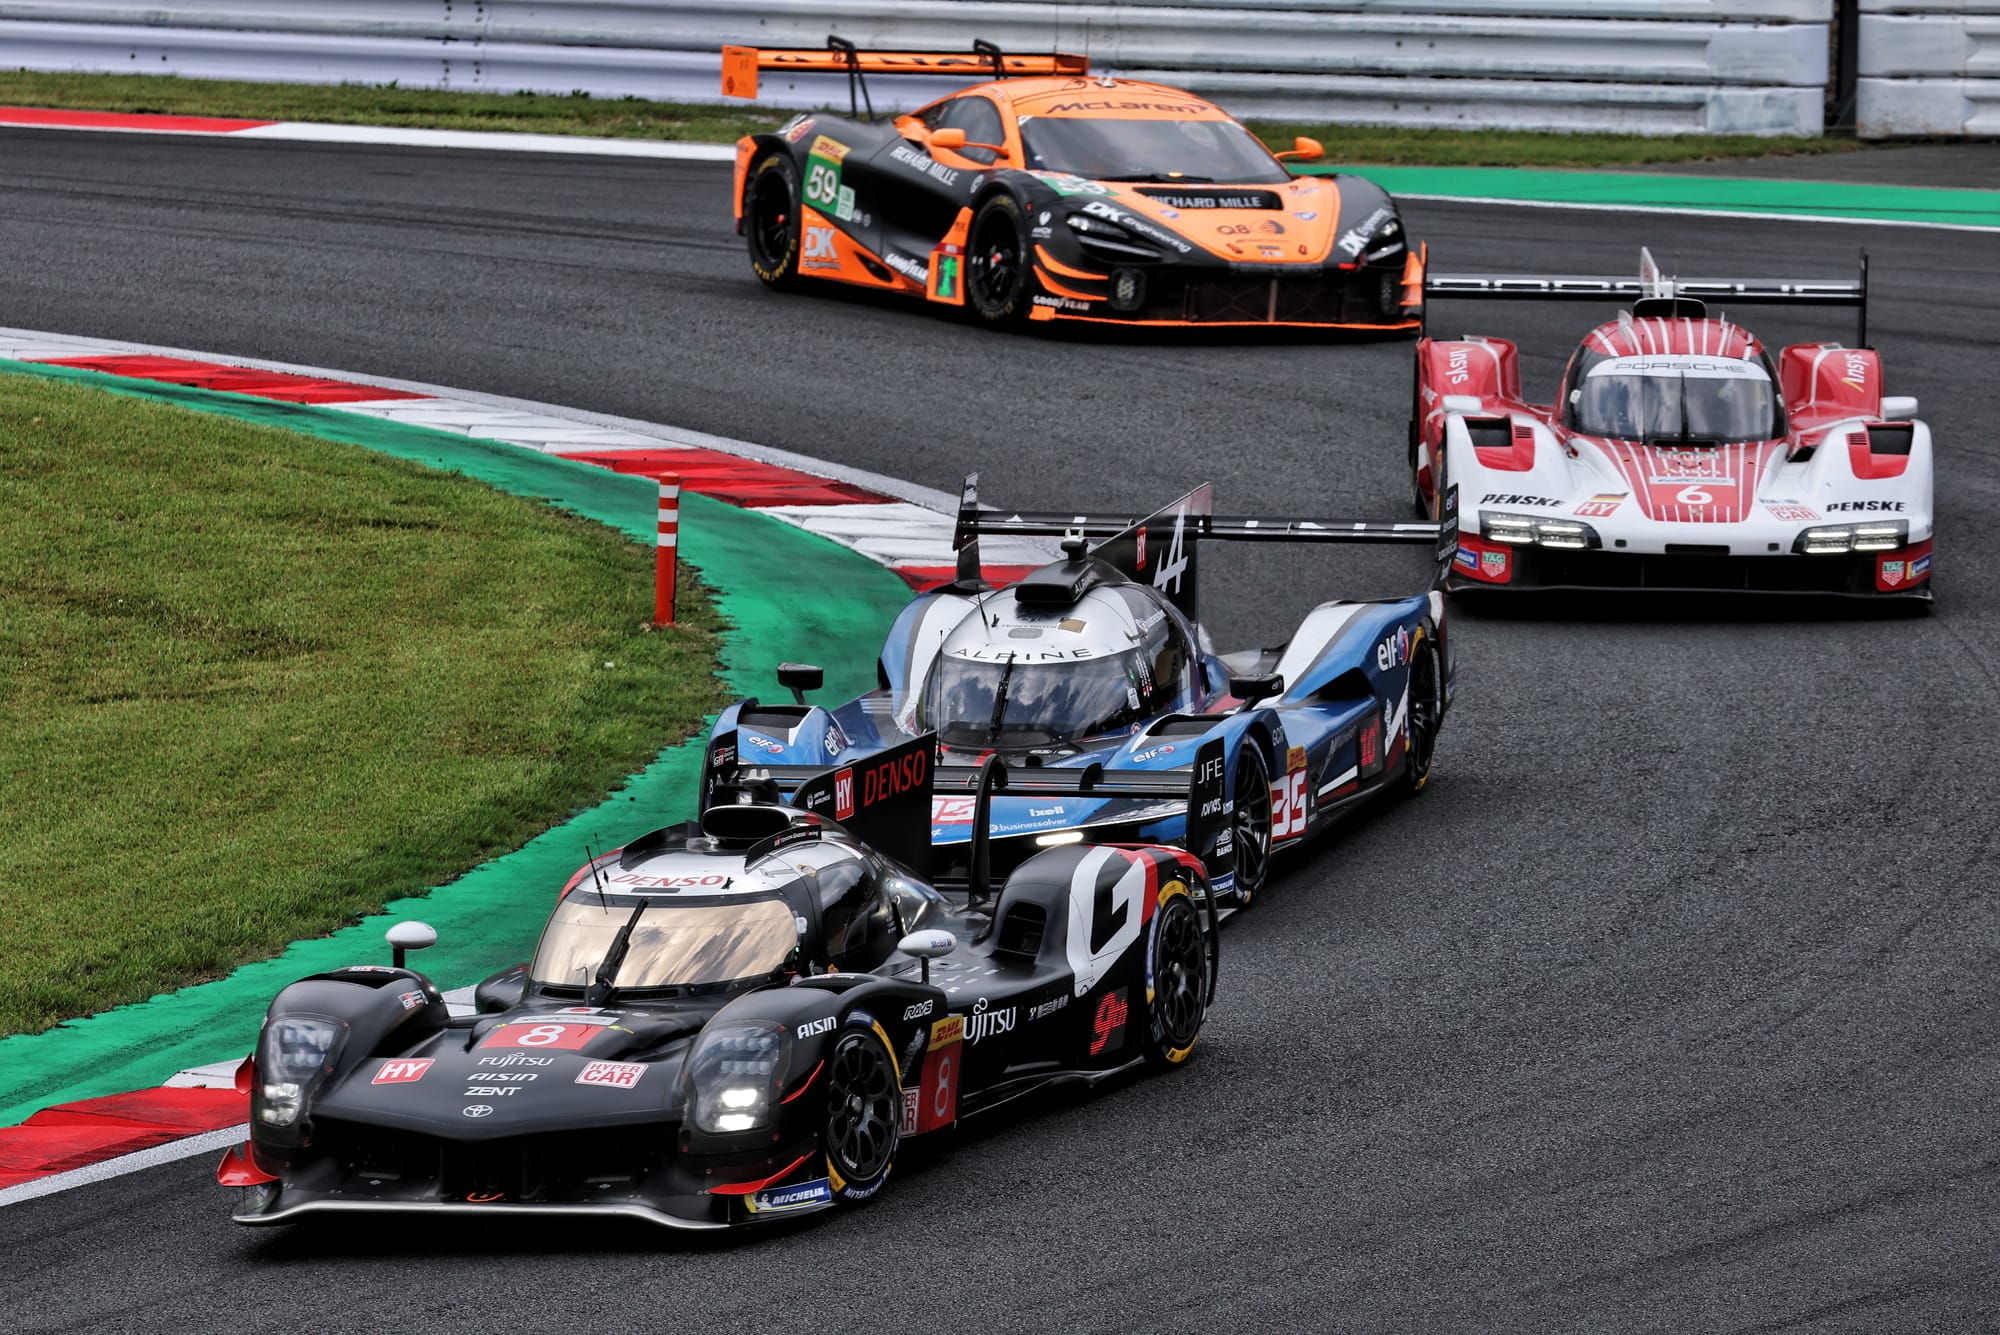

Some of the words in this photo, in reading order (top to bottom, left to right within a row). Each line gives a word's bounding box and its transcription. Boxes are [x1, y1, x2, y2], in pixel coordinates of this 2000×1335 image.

[1046, 101, 1199, 115] McLaren
[817, 141, 843, 159] DHL
[890, 146, 929, 172] RICHARD
[926, 158, 959, 186] MILLE
[807, 165, 838, 205] 59
[1218, 196, 1262, 208] MILLE
[1082, 201, 1128, 222] DK
[1122, 216, 1192, 253] Engineering
[1217, 224, 1251, 235] Q8
[805, 226, 838, 260] DK
[1616, 362, 1746, 374] PORSCHE
[1841, 352, 1870, 392] Ansys
[1479, 494, 1566, 508] PENSKE
[1676, 485, 1713, 504] 6
[1581, 502, 1612, 515] HY
[1826, 500, 1906, 512] PENSKE
[1776, 511, 1817, 520] CAR
[1137, 534, 1146, 563] HY
[1483, 553, 1504, 564] TAG
[1885, 563, 1904, 571] TAG
[953, 648, 1092, 661] ALPINE
[1377, 635, 1398, 672] elf
[748, 735, 770, 747] elf
[824, 725, 841, 757] elf
[1132, 749, 1159, 763] elf
[864, 749, 926, 807] DENSO
[1198, 757, 1223, 784] JFE
[708, 779, 714, 795] 8
[836, 777, 852, 812] HY
[1272, 769, 1307, 838] 35
[999, 818, 1068, 832] businessolver
[611, 873, 724, 888] DENSO
[903, 999, 933, 1021] RAYS
[797, 1015, 838, 1040] AISIN
[935, 1019, 962, 1043] DHL
[962, 1005, 1017, 1047] UJITSU
[517, 1025, 566, 1046] 8
[477, 1052, 555, 1068] FUJITSU
[590, 1063, 641, 1073] HYPER
[378, 1061, 429, 1080] HY
[466, 1072, 539, 1081] AISIN
[583, 1069, 636, 1085] CAR
[463, 1086, 522, 1096] ZENT
[934, 1055, 951, 1118] 8
[772, 1186, 825, 1205] MICHELIN
